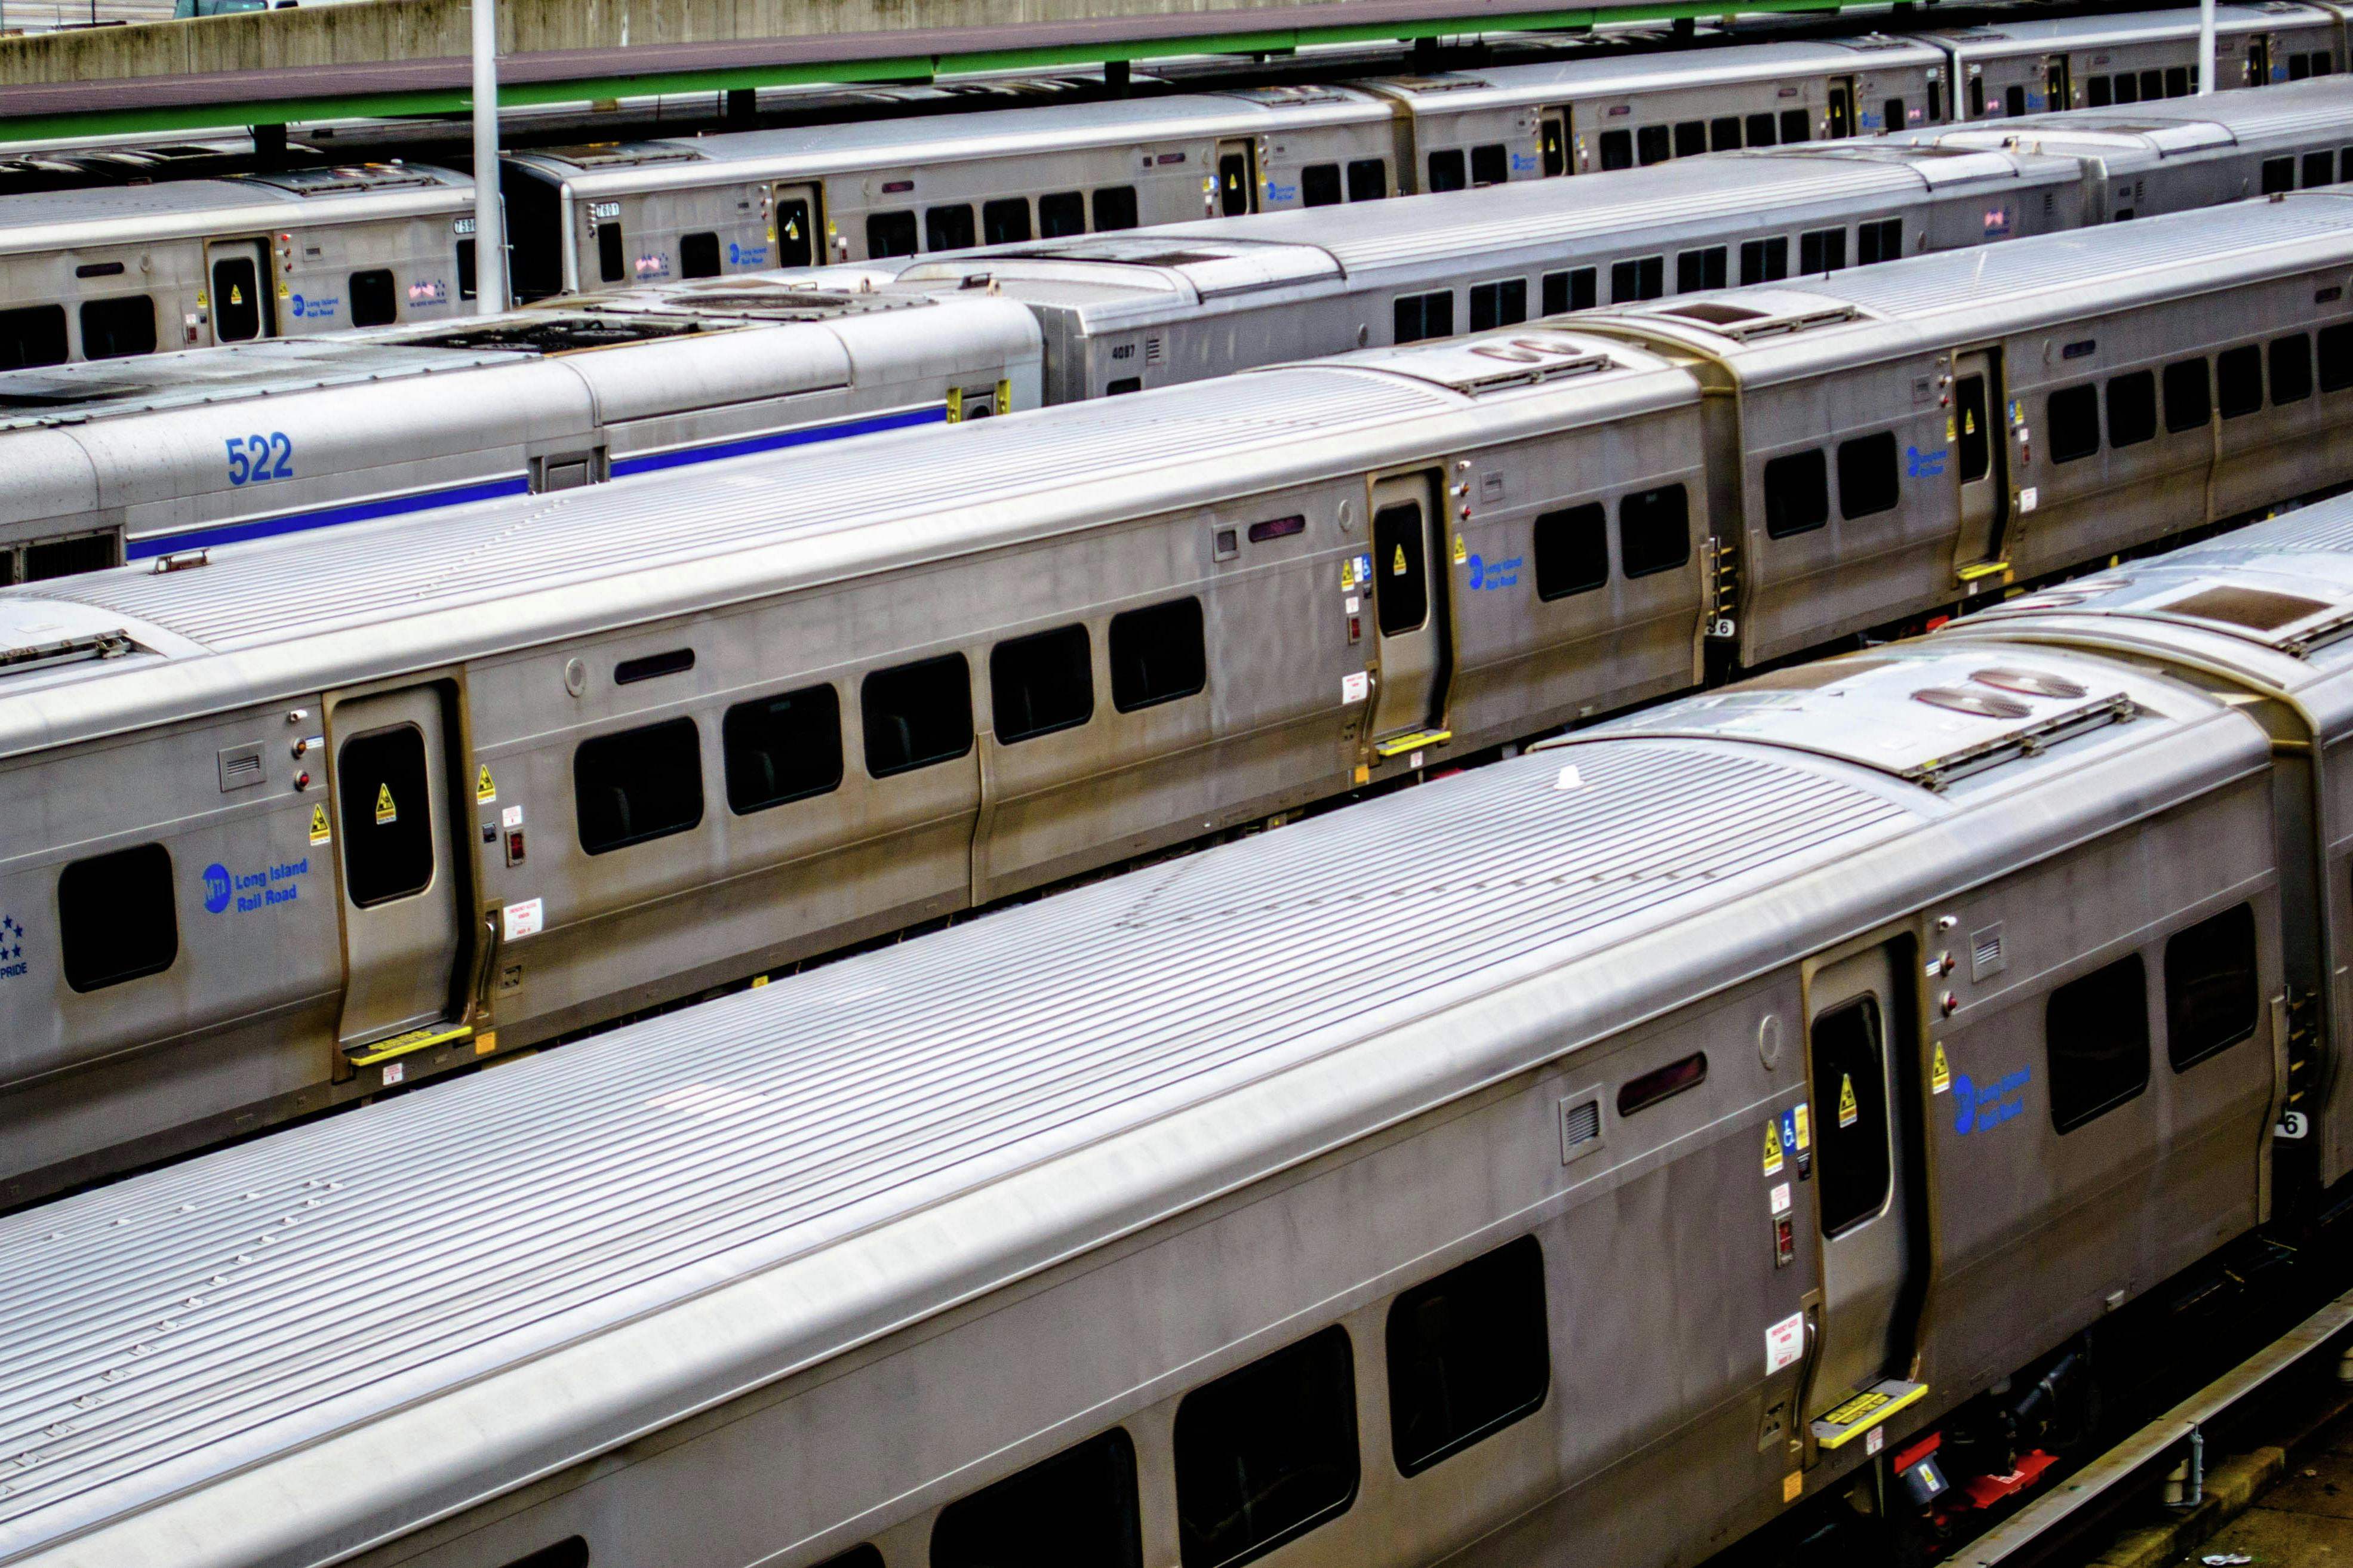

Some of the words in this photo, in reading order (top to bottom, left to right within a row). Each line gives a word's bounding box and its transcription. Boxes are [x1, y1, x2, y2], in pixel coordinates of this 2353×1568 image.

[226, 432, 293, 486] 522
[235, 872, 266, 890] Long
[270, 858, 308, 881] Island
[236, 892, 262, 913] Rail
[265, 883, 297, 906] Road
[0, 962, 27, 979] PRIDE
